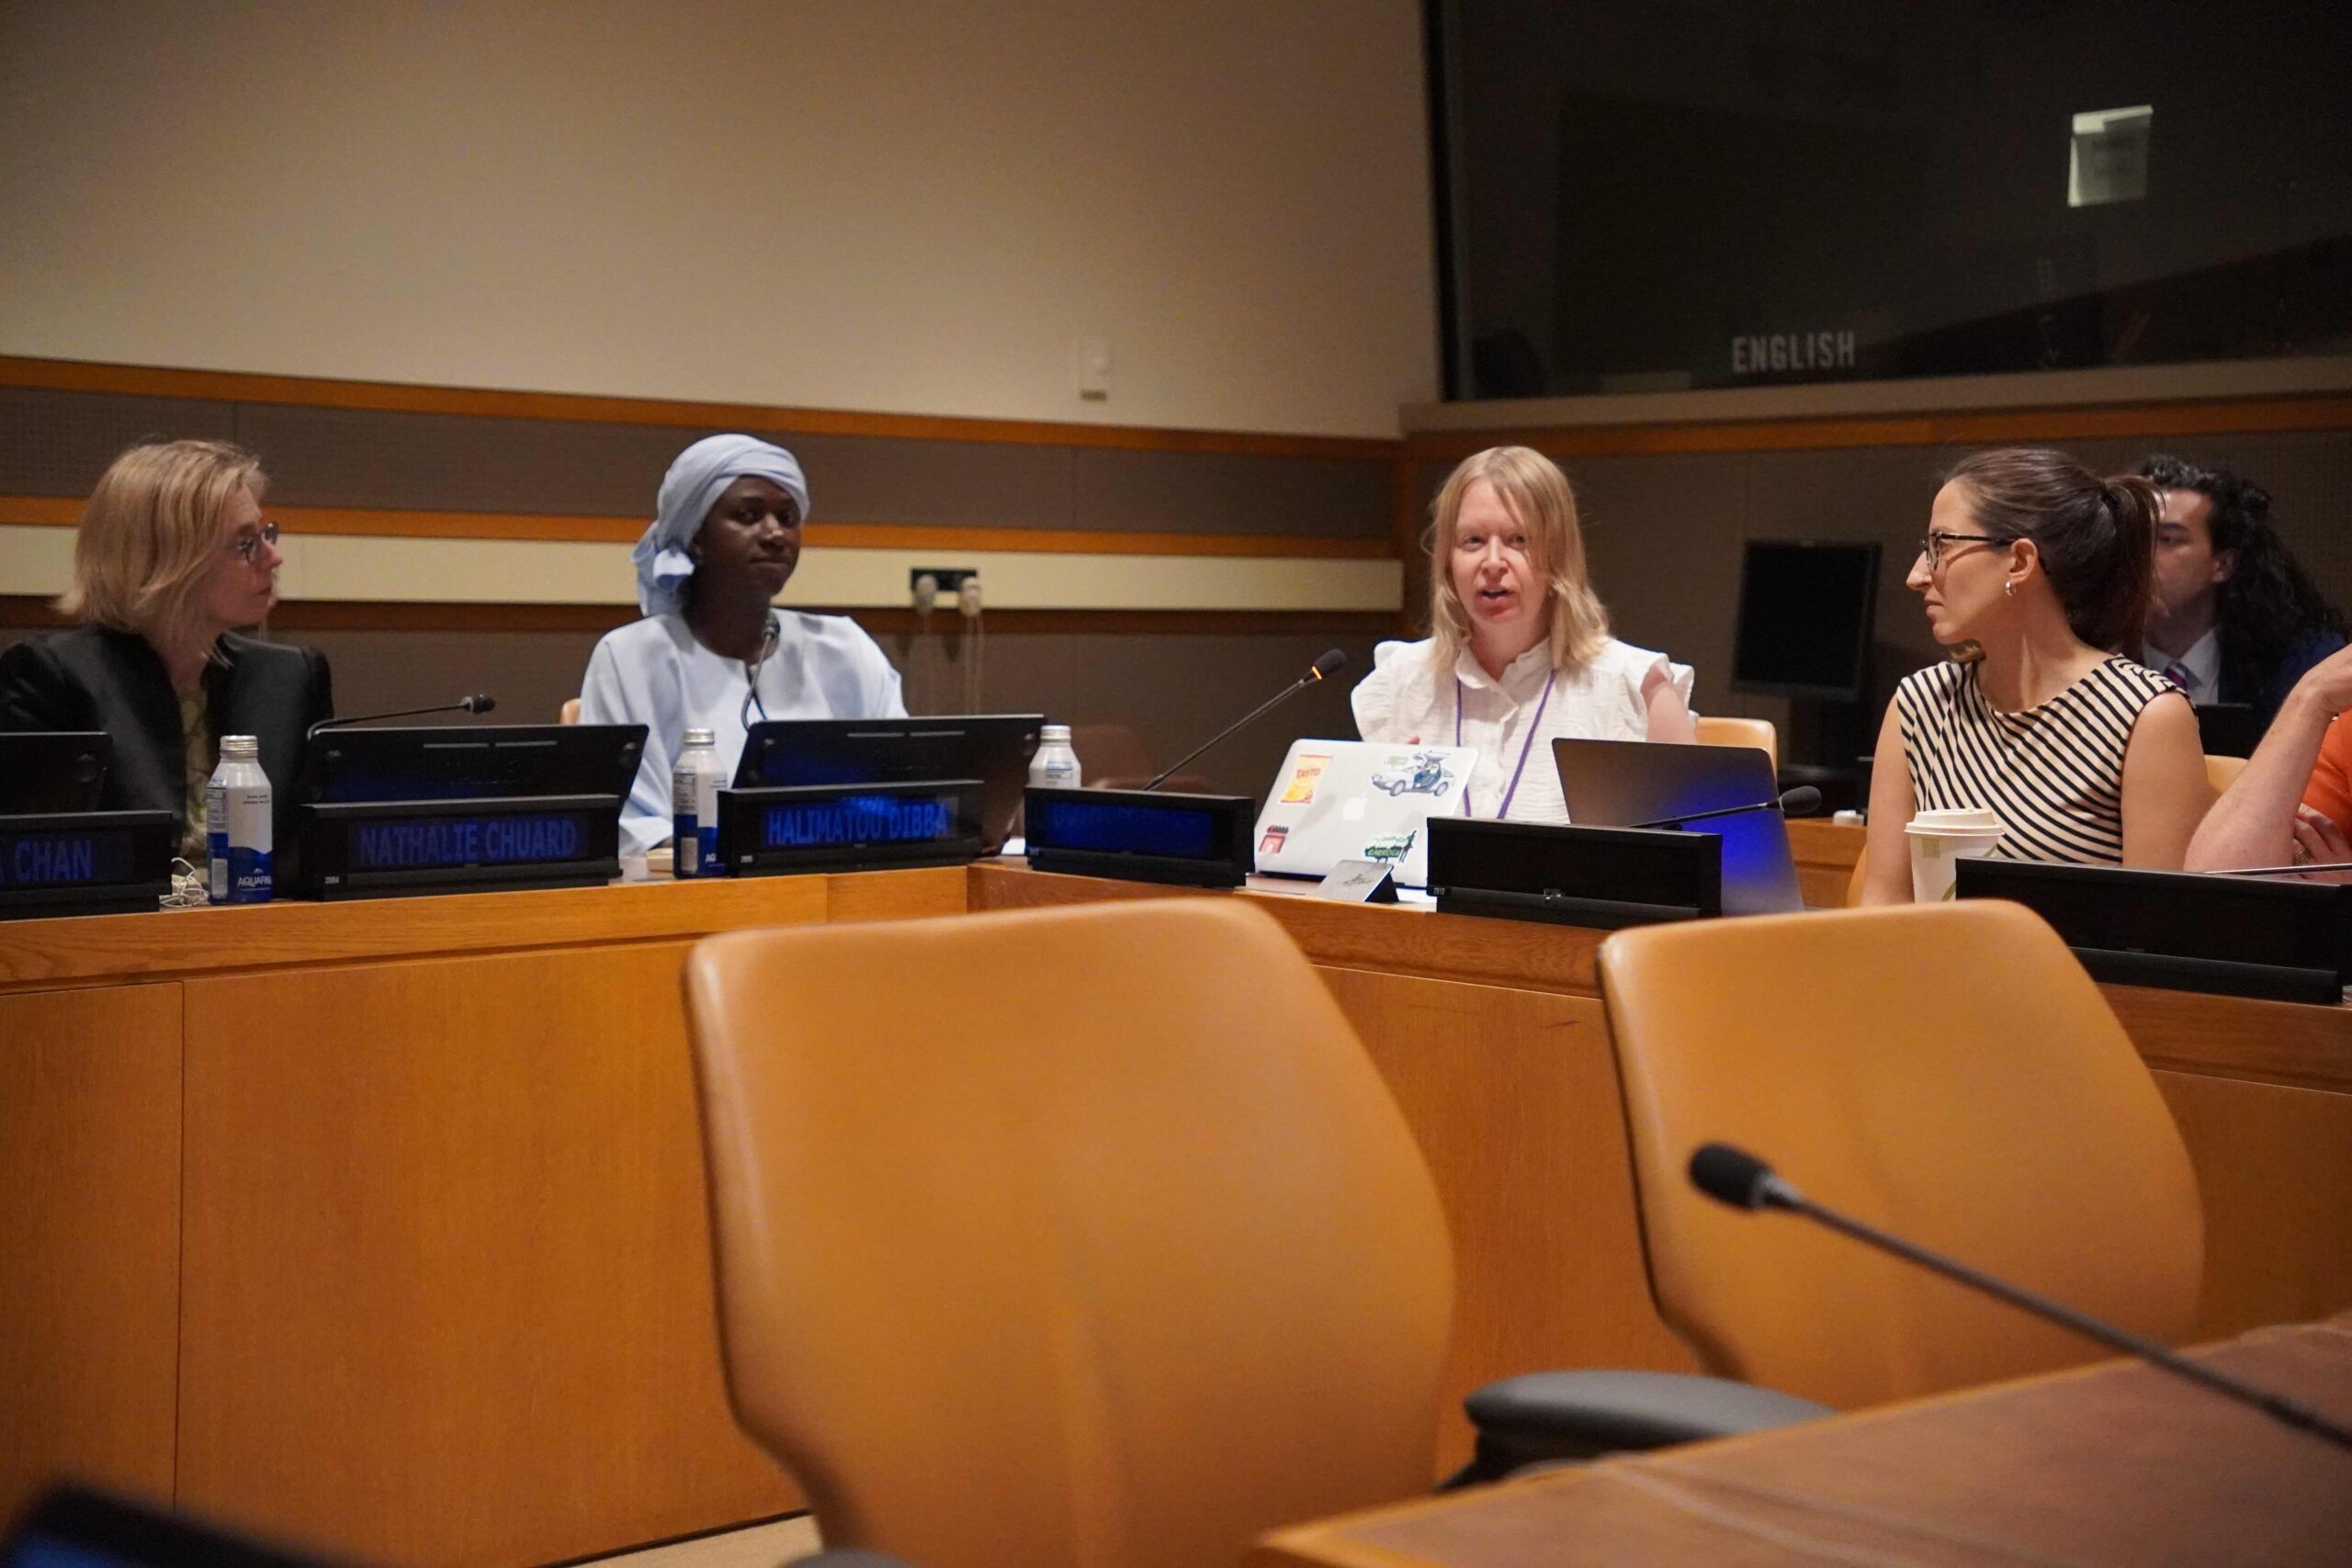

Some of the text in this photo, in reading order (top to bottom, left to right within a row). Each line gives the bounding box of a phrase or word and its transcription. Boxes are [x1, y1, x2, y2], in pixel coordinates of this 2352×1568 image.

[1733, 331, 1856, 373] ENGLISH
[15, 838, 93, 882] CHAN
[358, 817, 577, 866] NATHALIE CHUARD
